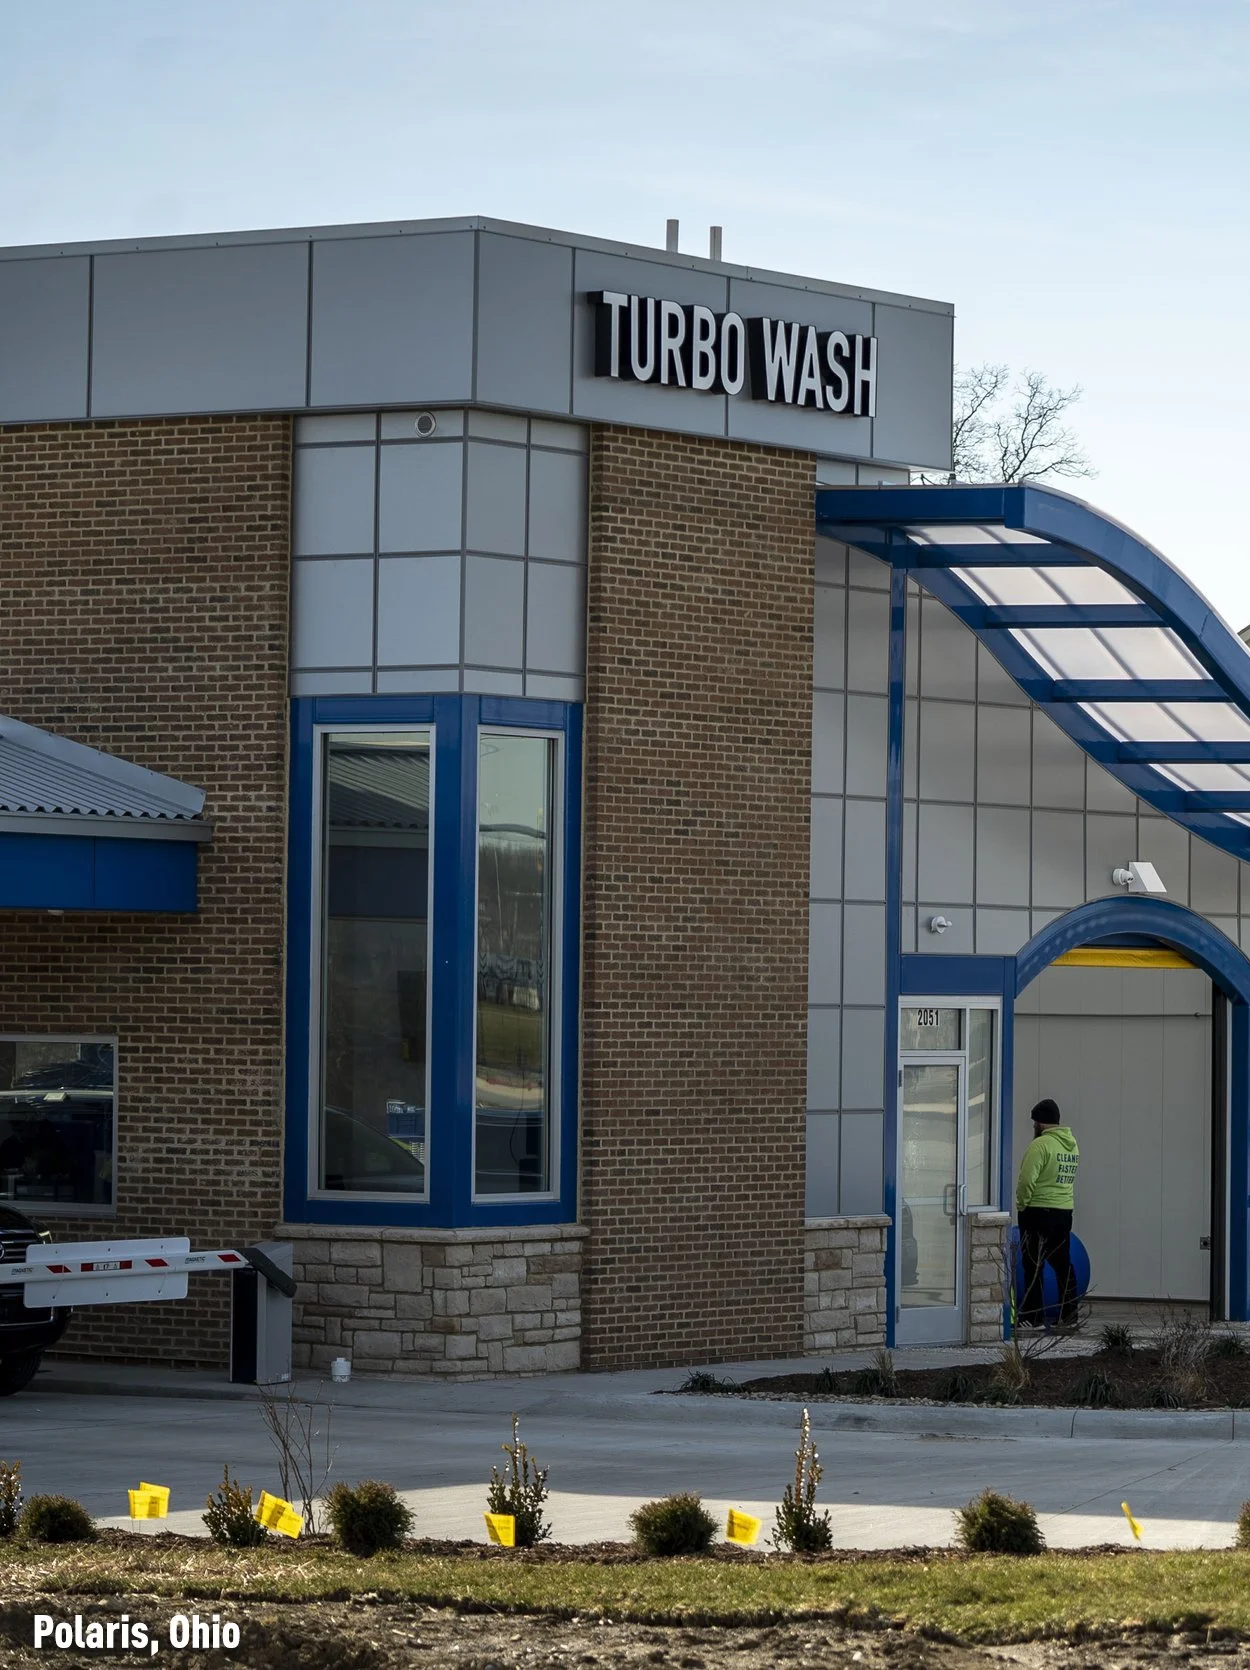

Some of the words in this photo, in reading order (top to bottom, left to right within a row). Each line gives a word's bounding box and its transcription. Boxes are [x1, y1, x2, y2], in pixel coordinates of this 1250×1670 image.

[598, 290, 746, 396] TURBO
[758, 316, 879, 418] WASH
[917, 1009, 940, 1026] 2051
[1056, 1152, 1080, 1164] CLEANE
